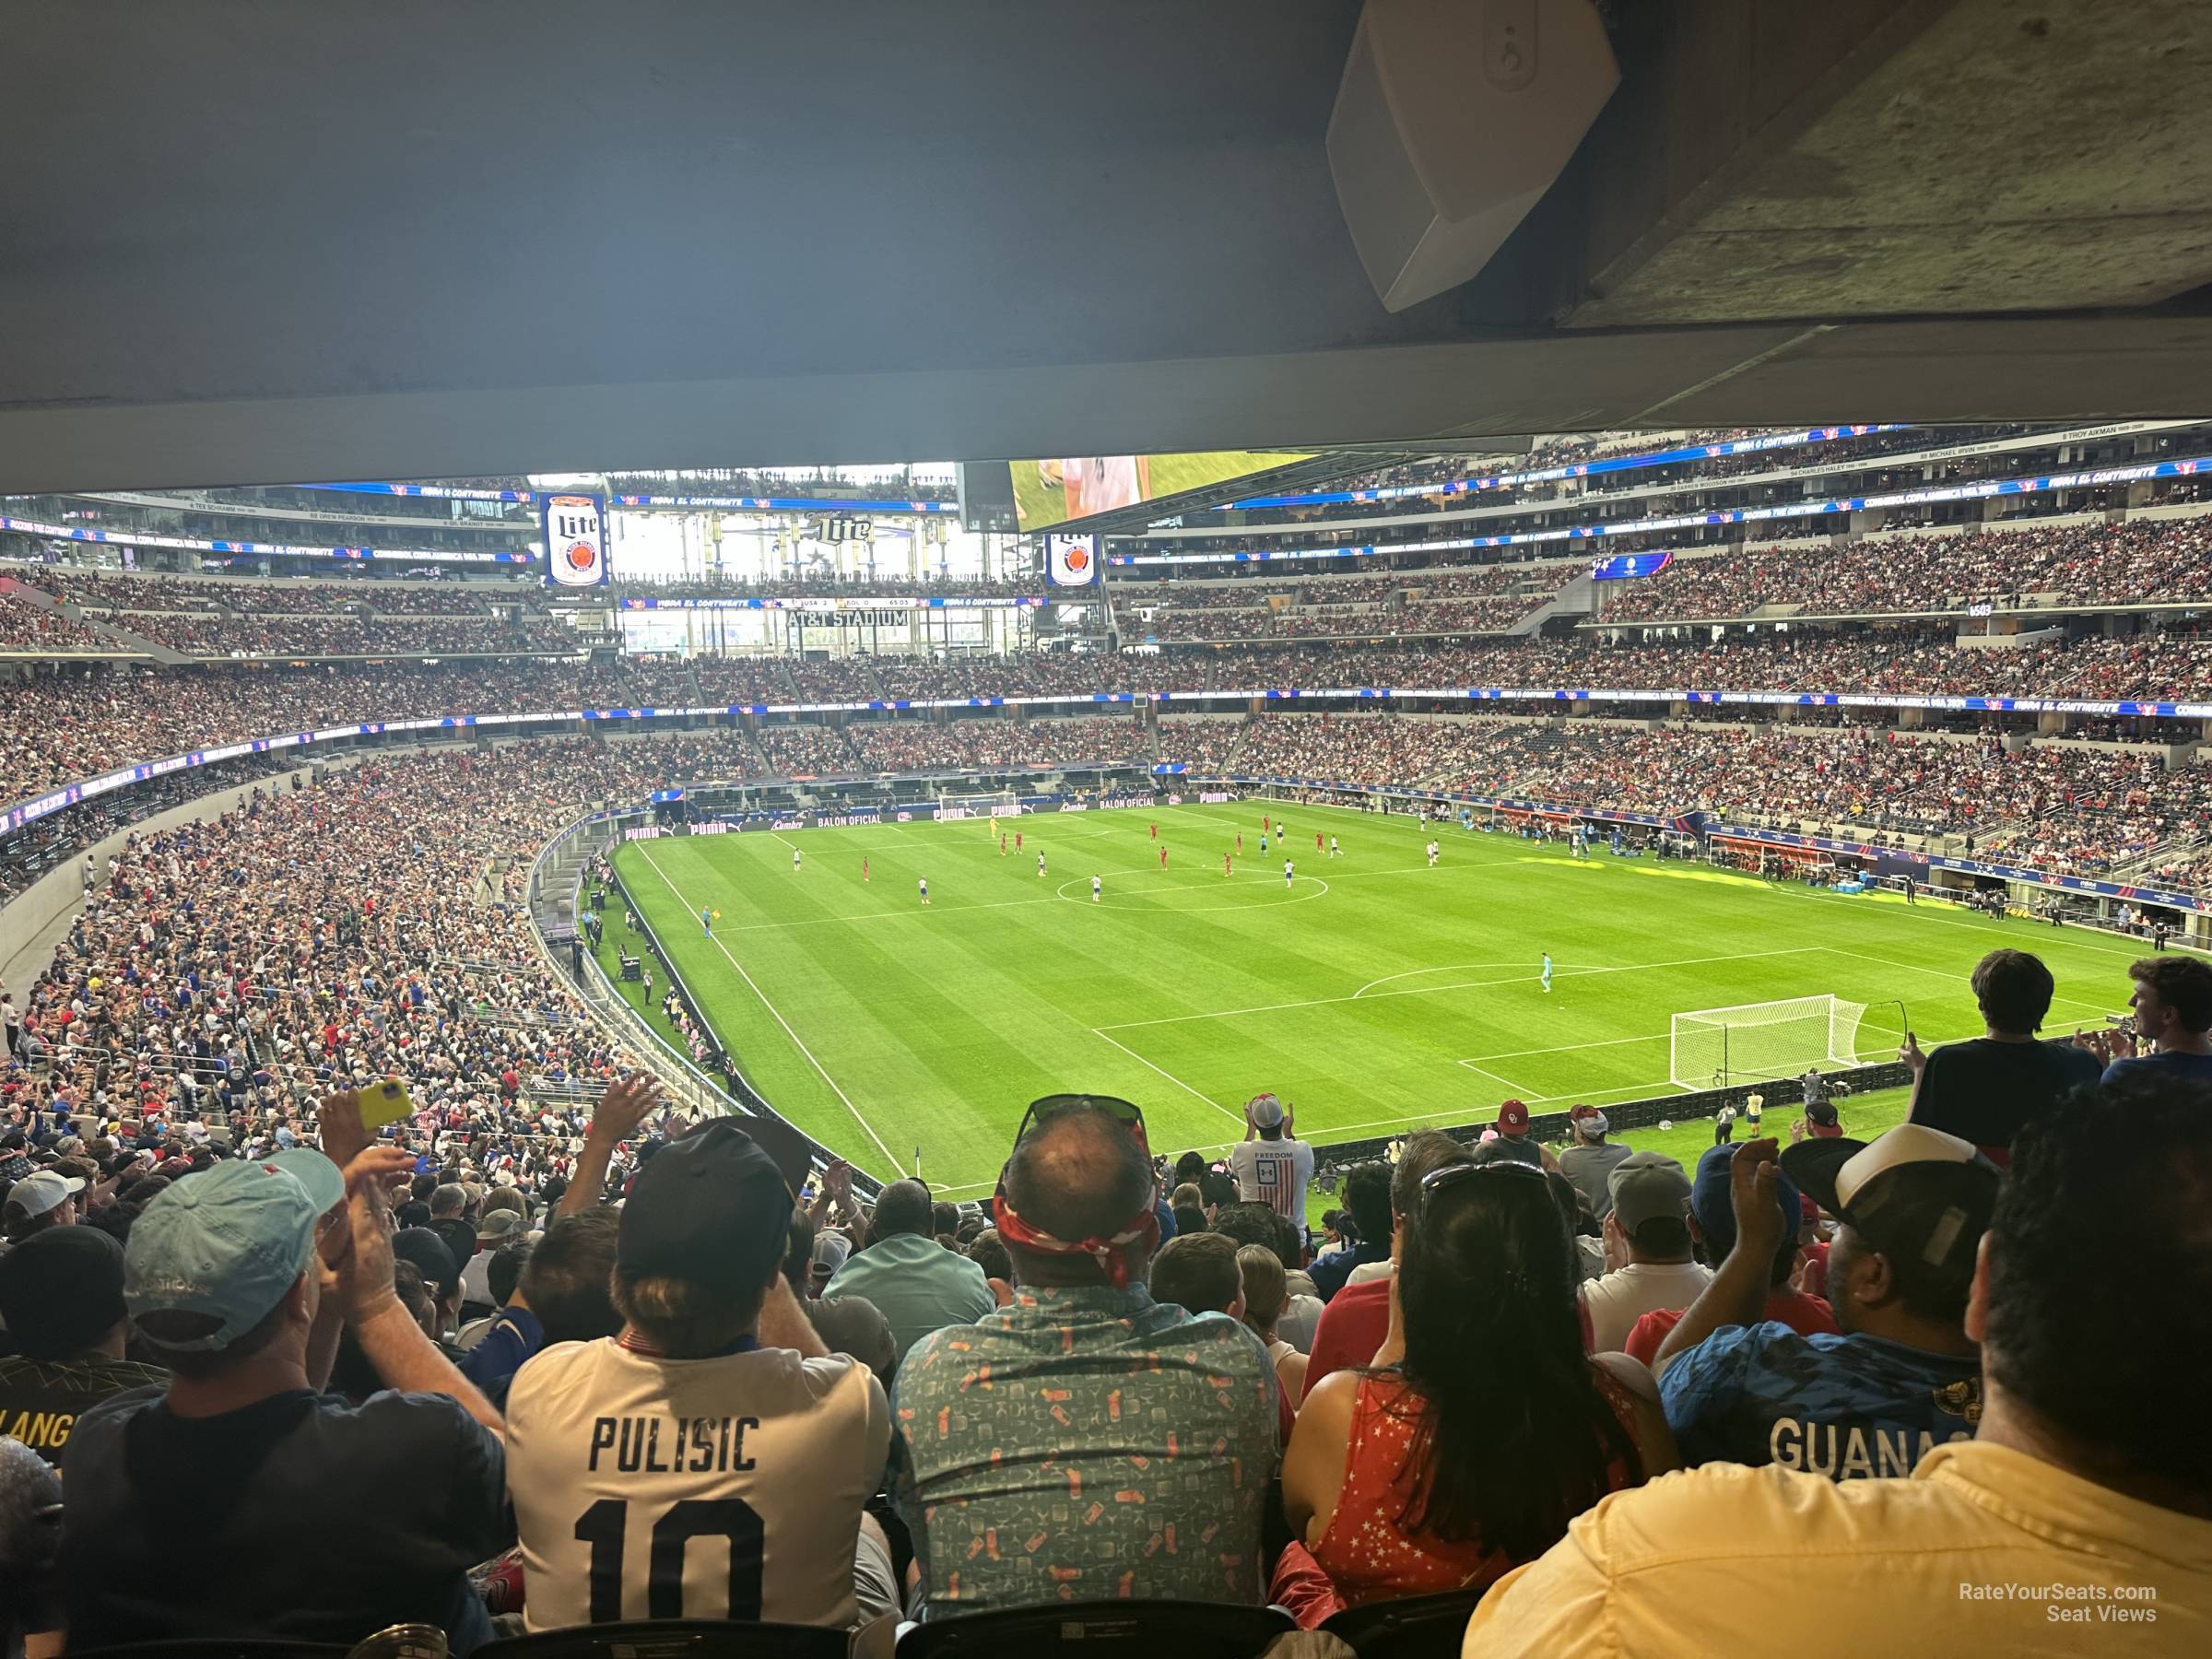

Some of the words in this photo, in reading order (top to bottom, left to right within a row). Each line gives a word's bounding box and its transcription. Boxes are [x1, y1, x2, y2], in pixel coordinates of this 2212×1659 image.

[2088, 426, 2117, 436] AIKMAN
[1929, 450, 1956, 458] MICHAEL
[1798, 466, 1825, 477] CHARLES
[1825, 465, 1845, 473] HALEY
[559, 515, 597, 539] Lite
[817, 517, 870, 547] Lite
[786, 610, 830, 627] AT&T
[832, 610, 908, 627] STADIUM
[2013, 700, 2041, 711] VIBRA
[2042, 701, 2055, 711] EL
[2056, 701, 2120, 712] CONTINENTE
[1126, 797, 1156, 808] OFICIAL
[1199, 792, 1229, 804] PUMA
[849, 814, 882, 826] OFICIAL
[625, 827, 660, 841] PUMA
[690, 822, 726, 835] PUMA
[589, 1417, 759, 1473] PULISIC
[574, 1499, 765, 1623] 10
